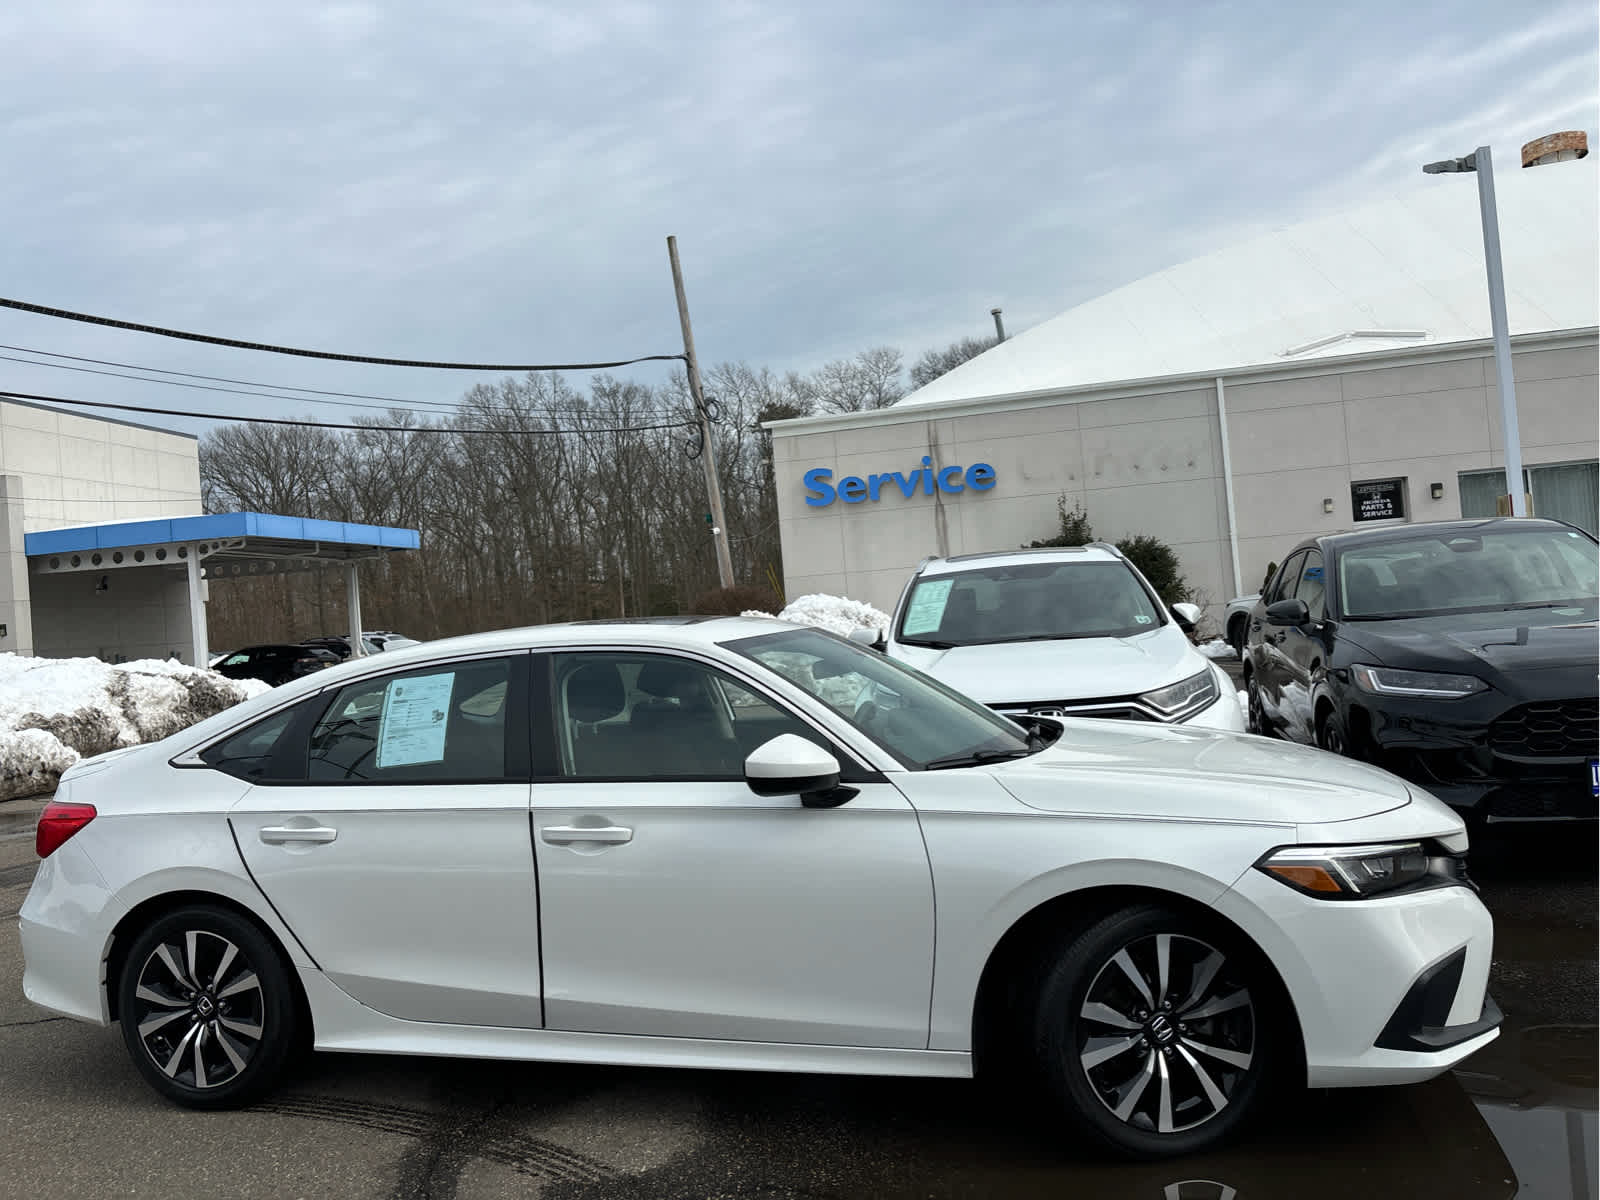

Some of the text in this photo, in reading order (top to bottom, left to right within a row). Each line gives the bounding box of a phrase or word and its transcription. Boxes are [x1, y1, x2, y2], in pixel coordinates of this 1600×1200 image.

[803, 456, 996, 507] Service
[1361, 503, 1385, 511] PARTS
[1362, 509, 1393, 518] SERVICE
